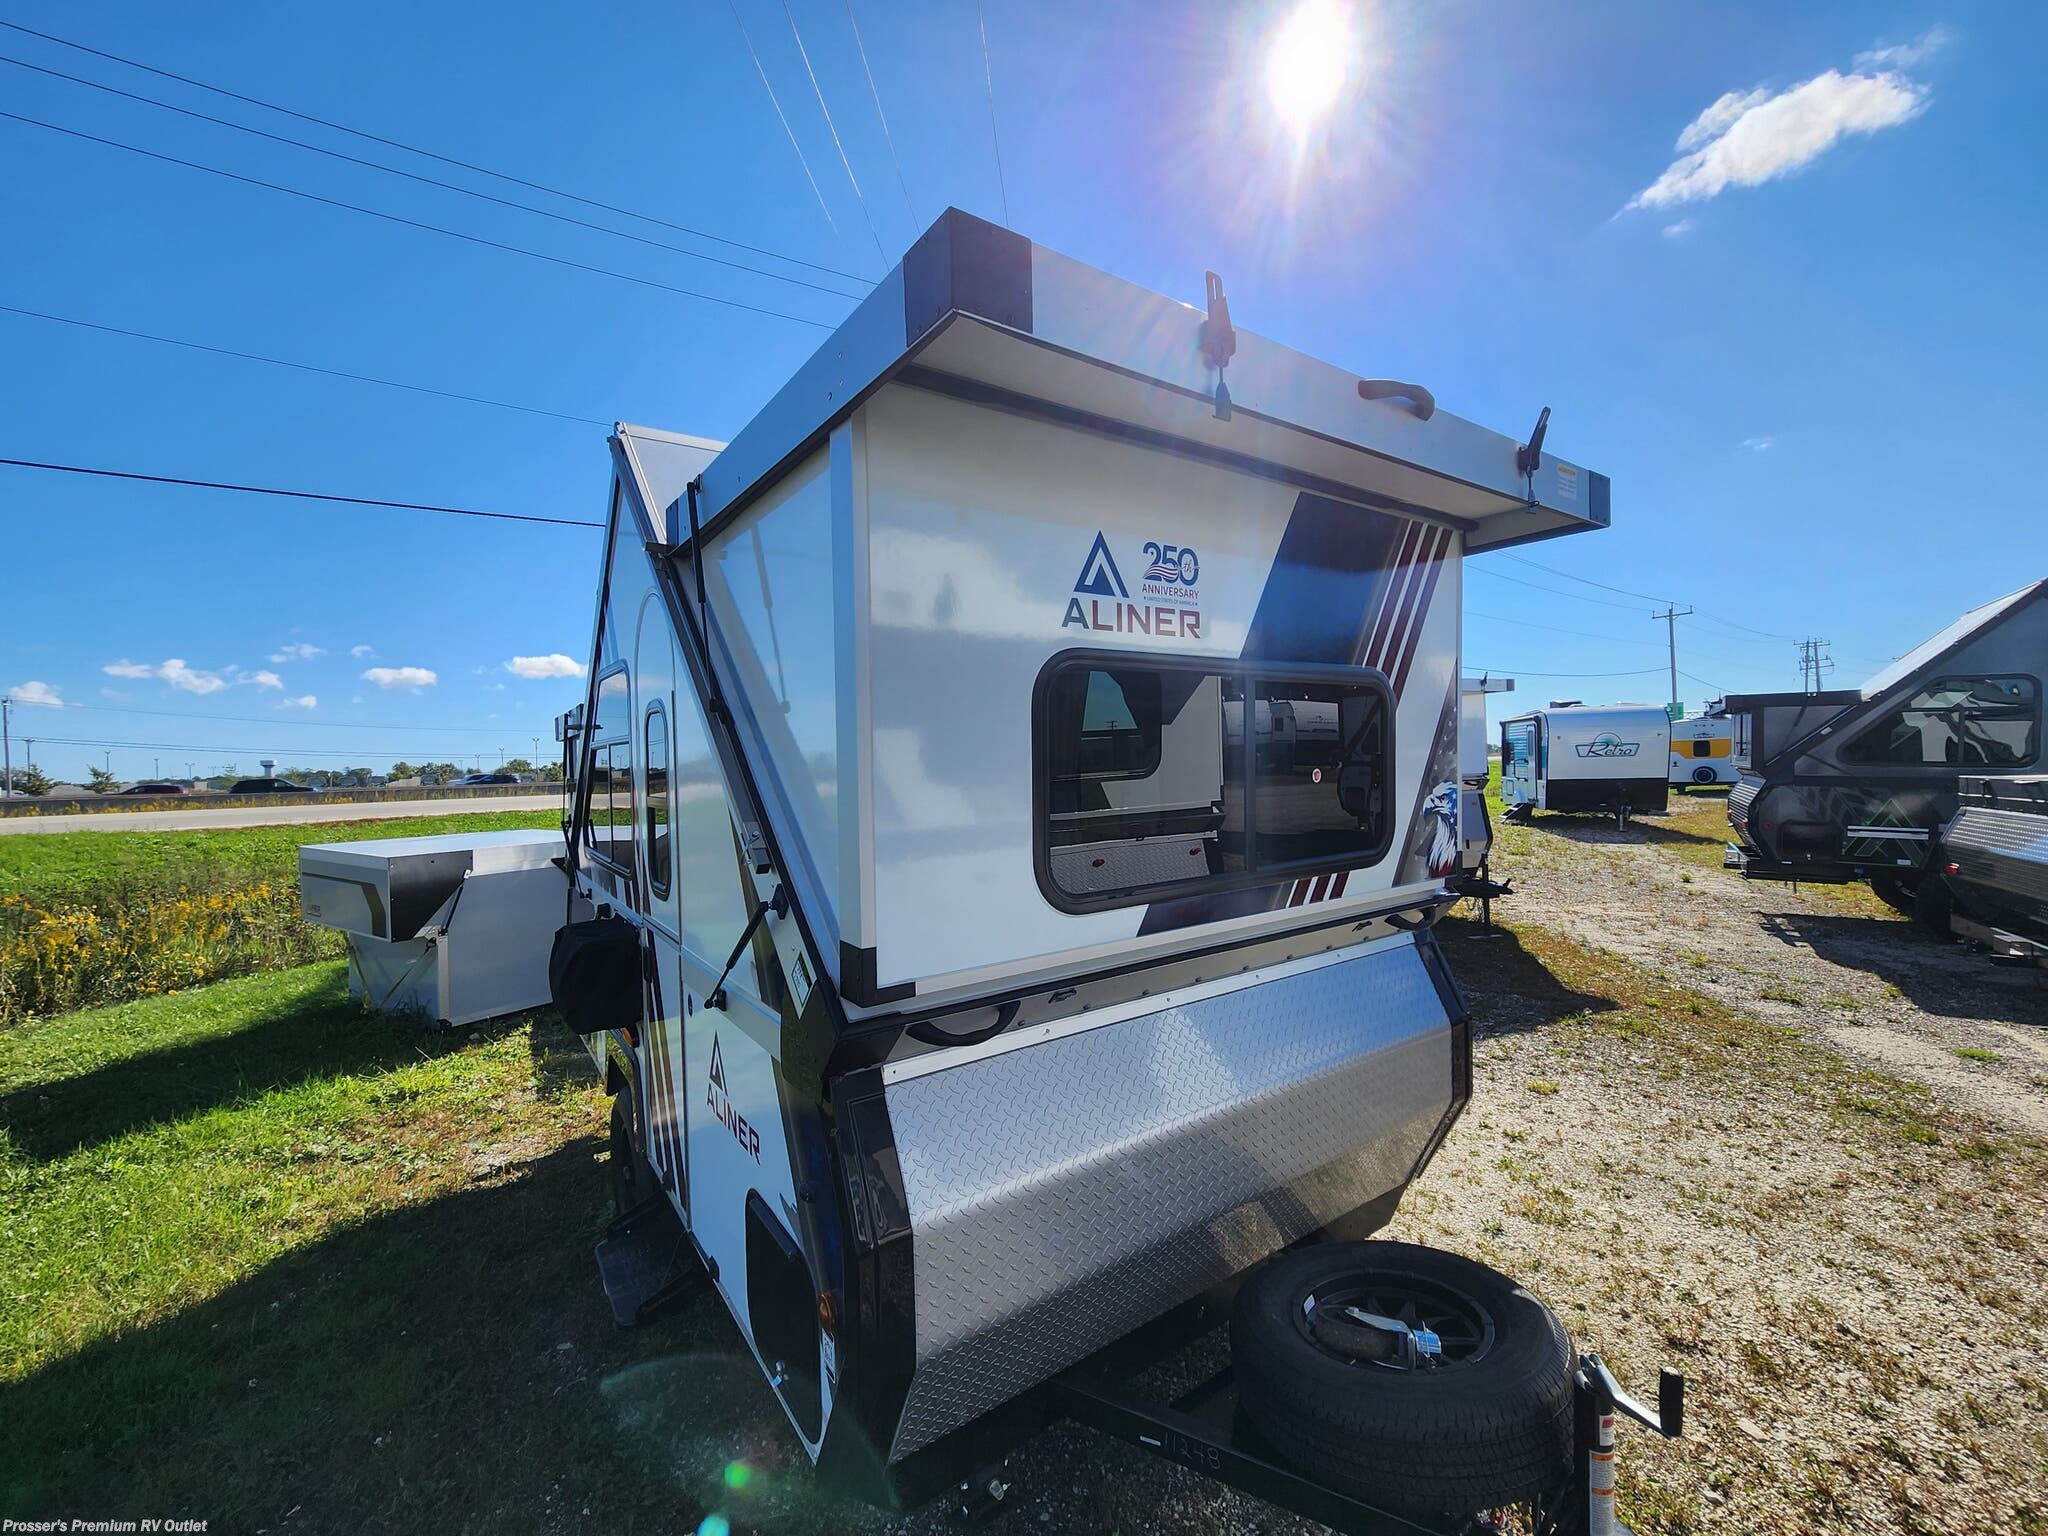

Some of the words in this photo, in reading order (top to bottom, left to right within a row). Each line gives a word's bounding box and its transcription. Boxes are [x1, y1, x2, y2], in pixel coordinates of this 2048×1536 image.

[1141, 583, 1200, 600] ANNIVERSARY
[1061, 597, 1201, 639] ALINER
[1586, 741, 1632, 757] Retro
[706, 1082, 761, 1166] ALINER
